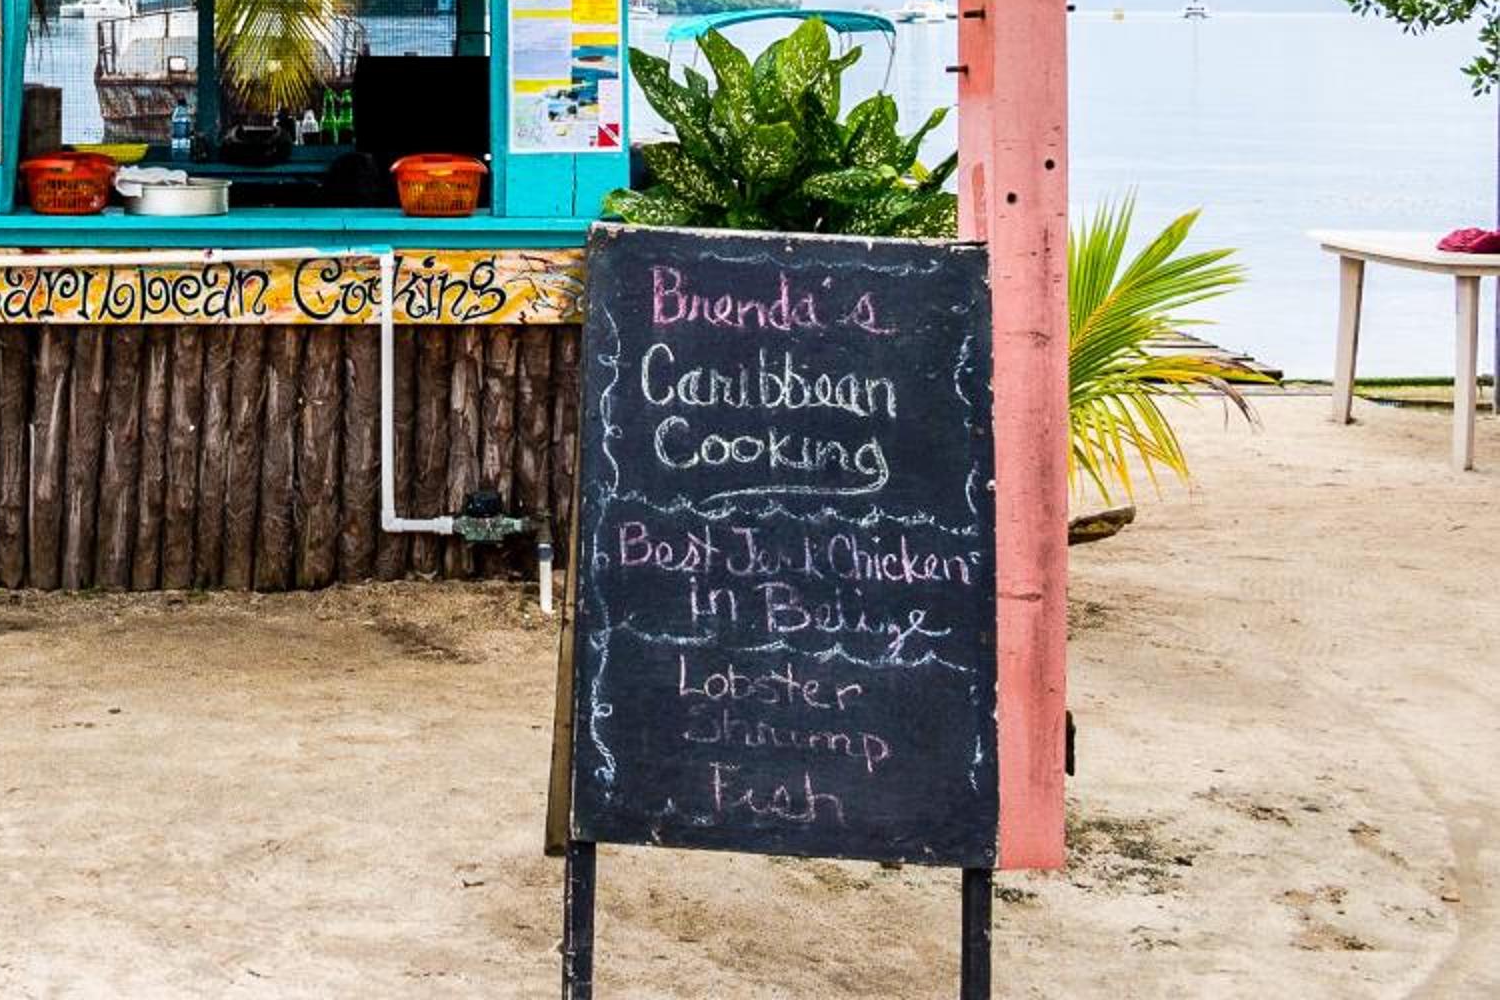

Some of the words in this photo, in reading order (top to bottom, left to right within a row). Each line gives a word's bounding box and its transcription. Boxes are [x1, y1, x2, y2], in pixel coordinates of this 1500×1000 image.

[641, 342, 897, 419] Caribbean
[654, 415, 890, 495] Cooking
[618, 520, 718, 573] Best
[727, 526, 824, 579] Jerk
[828, 534, 972, 585] Chicken
[690, 576, 738, 621] in
[754, 581, 952, 657] Belize
[679, 653, 863, 711] Lobster
[681, 702, 889, 773] Shrimp
